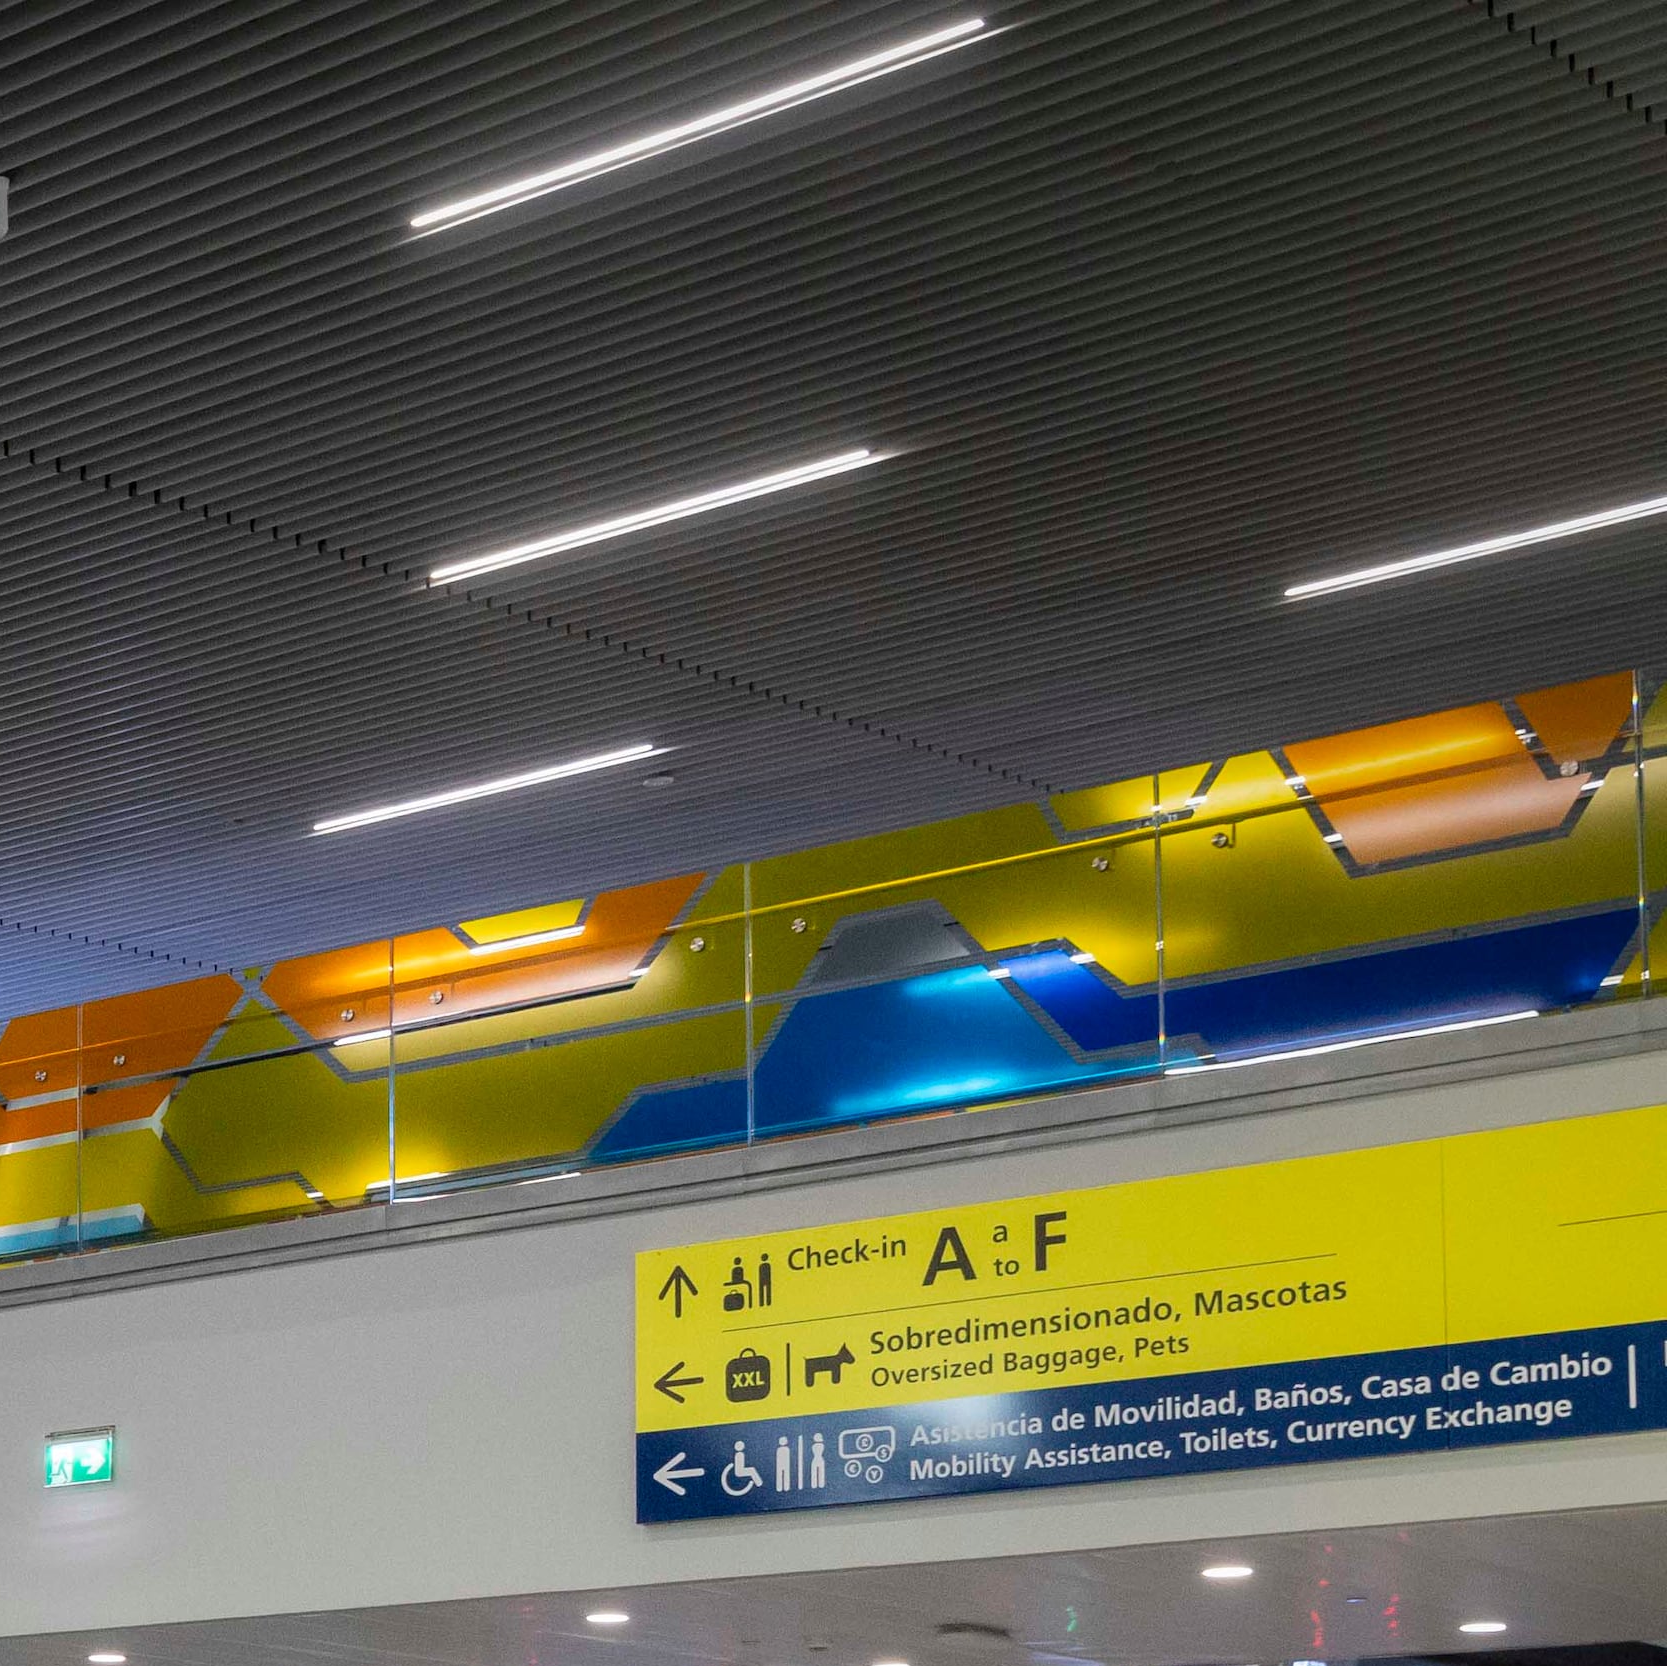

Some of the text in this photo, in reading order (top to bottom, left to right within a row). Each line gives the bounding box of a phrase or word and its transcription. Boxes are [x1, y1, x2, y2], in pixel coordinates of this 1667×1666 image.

[788, 1211, 1068, 1287] Check-in A a F
[994, 1256, 1020, 1278] to
[870, 1279, 1348, 1355] Sobredimensionado, Mascotas
[730, 1370, 765, 1388] XXL
[871, 1333, 1190, 1388] Oversized Baggage, Pets
[910, 1351, 1613, 1447] Asistencia de Movilidad, Baños, Casa de Cambio
[910, 1398, 1573, 1482] Mobility Assistance, Toilets, Currency Exchange
